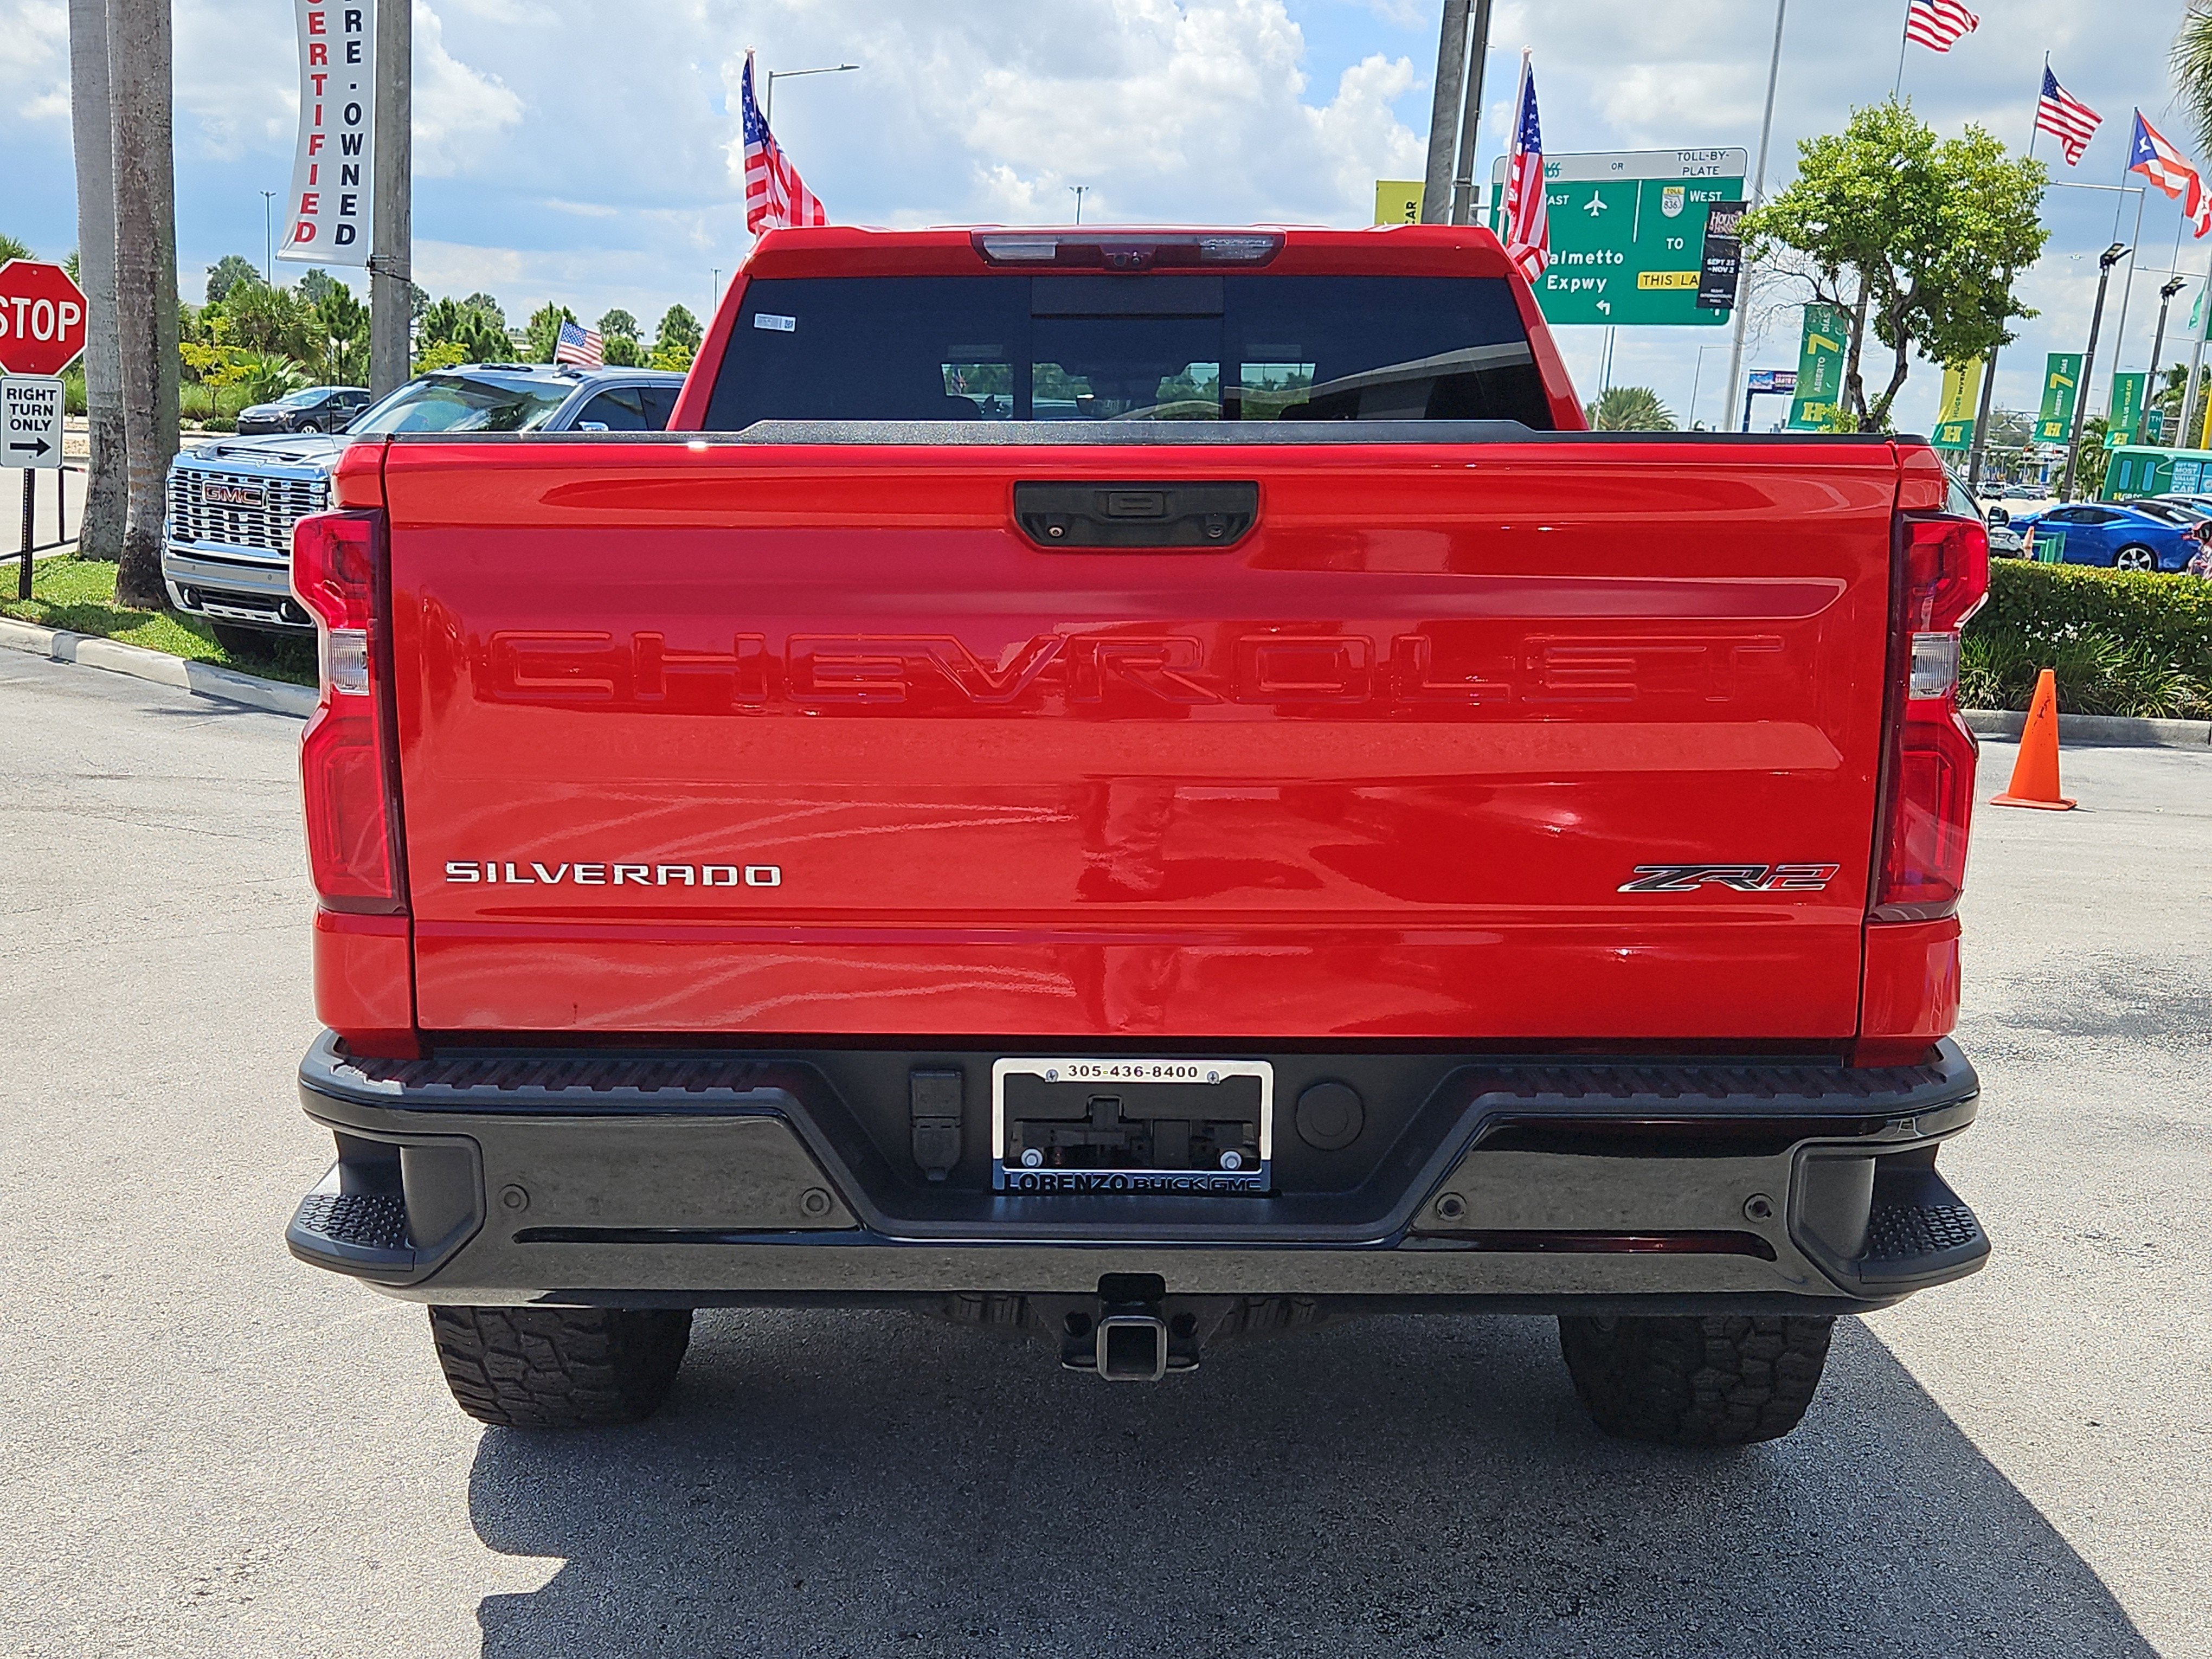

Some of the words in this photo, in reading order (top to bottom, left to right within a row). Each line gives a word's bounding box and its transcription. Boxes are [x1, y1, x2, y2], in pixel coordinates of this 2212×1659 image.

[294, 0, 327, 242] ERTIFIED
[335, 0, 364, 245] RE-OWNED
[1677, 151, 1729, 162] TOLL-BY-
[1682, 166, 1720, 176] PLATE
[1546, 195, 1570, 205] AST
[1690, 190, 1722, 202] WEST
[1664, 201, 1677, 209] 836
[1710, 210, 1740, 227] HOUS
[1666, 237, 1683, 250] TO
[1549, 249, 1624, 265] almetto
[1547, 274, 1607, 293] Expwy
[1643, 275, 1673, 286] THIS
[1681, 275, 1699, 286] LA
[1808, 333, 1840, 355] 7
[1814, 356, 1826, 393] ABIERTO
[2049, 372, 2074, 389] 7
[7, 387, 57, 401] RIGHT
[9, 403, 54, 416] TURN
[1801, 402, 1825, 422] H
[10, 419, 52, 431] ONLY
[2043, 422, 2062, 437] H
[1941, 426, 1963, 442] H
[205, 484, 262, 505] GMC
[2172, 485, 2195, 494] CAR
[489, 629, 1786, 704] CHEVROLET
[445, 860, 783, 888] SILVERADO
[1616, 864, 1841, 892] ZR2
[1068, 1064, 1198, 1078] 305-436-8400
[1004, 1172, 1129, 1192] LORENZO
[1133, 1176, 1207, 1191] BUICK
[1212, 1178, 1261, 1192] GMC
